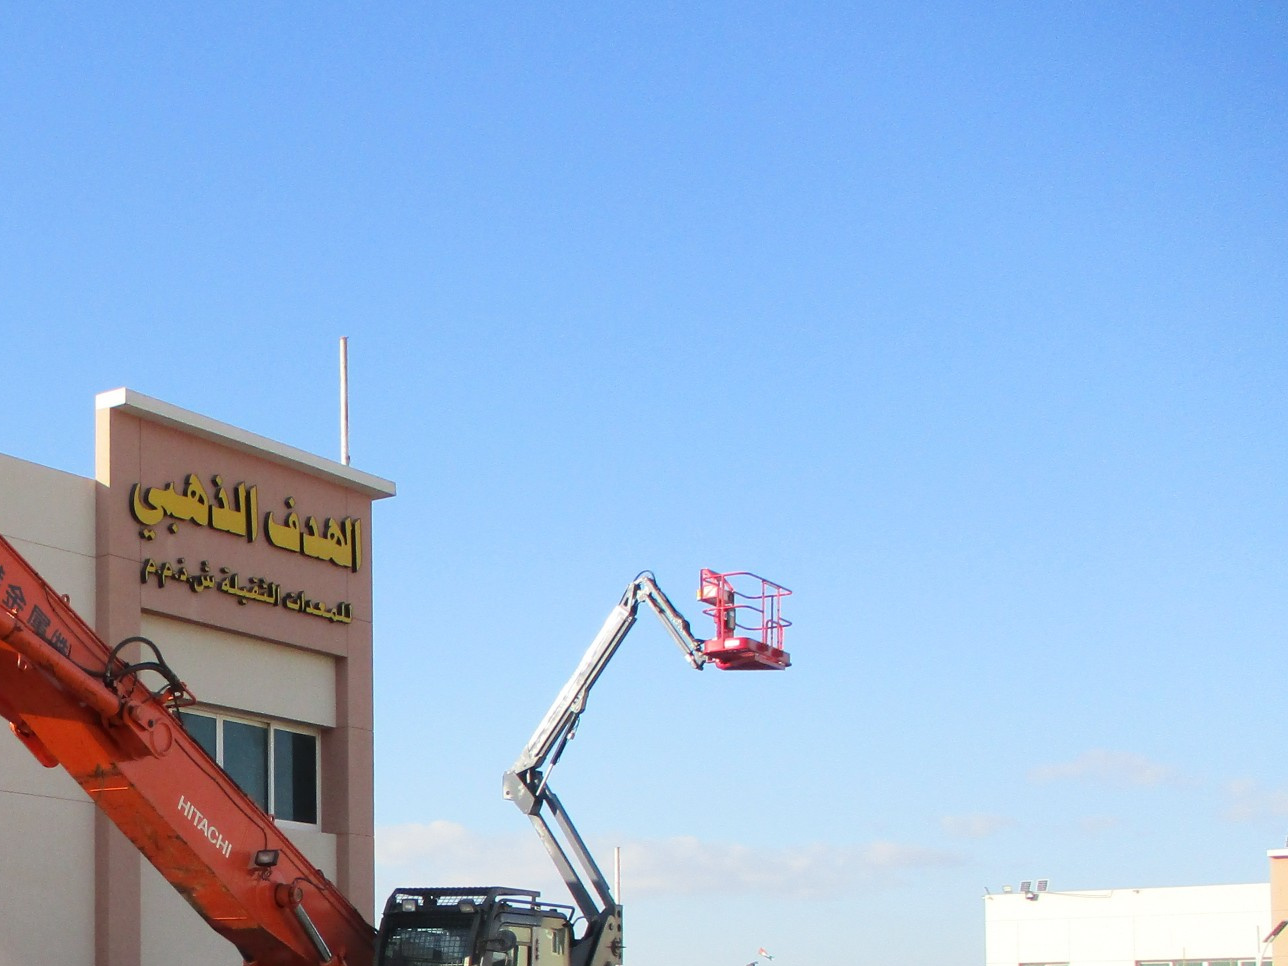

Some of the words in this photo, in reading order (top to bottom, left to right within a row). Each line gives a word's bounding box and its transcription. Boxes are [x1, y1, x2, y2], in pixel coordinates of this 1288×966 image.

[130, 473, 259, 542] الذهبي
[266, 497, 363, 572] الهدف
[217, 566, 280, 606] الثقيلة
[284, 590, 353, 624] للمعدات
[176, 795, 233, 859] HITACHI
